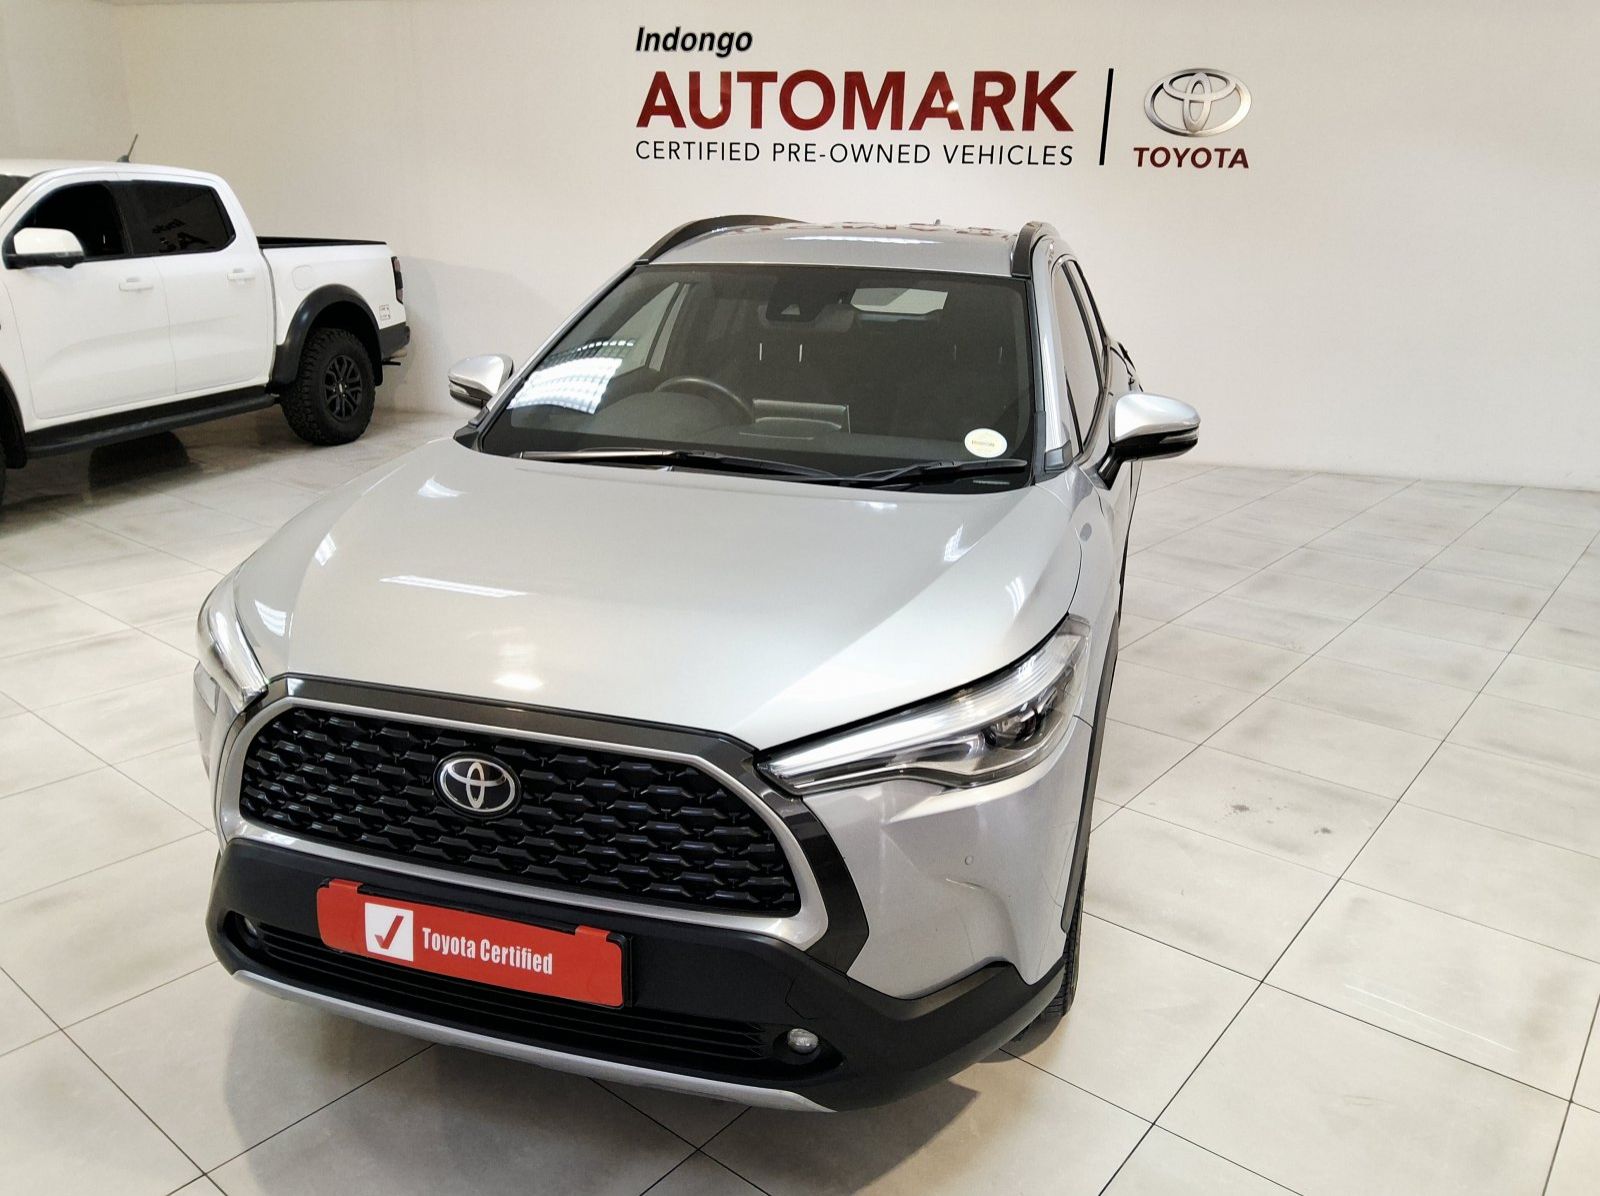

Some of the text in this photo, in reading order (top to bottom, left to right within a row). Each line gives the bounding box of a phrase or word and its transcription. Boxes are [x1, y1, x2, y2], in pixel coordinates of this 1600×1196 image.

[635, 26, 753, 58] Indongo
[636, 69, 1077, 132] AUTOMARK
[635, 140, 1073, 166] CERTIFIED PRE-OWNED VEHICLES
[1133, 146, 1249, 169] TOYOTA
[422, 927, 553, 975] Toyota Certified
